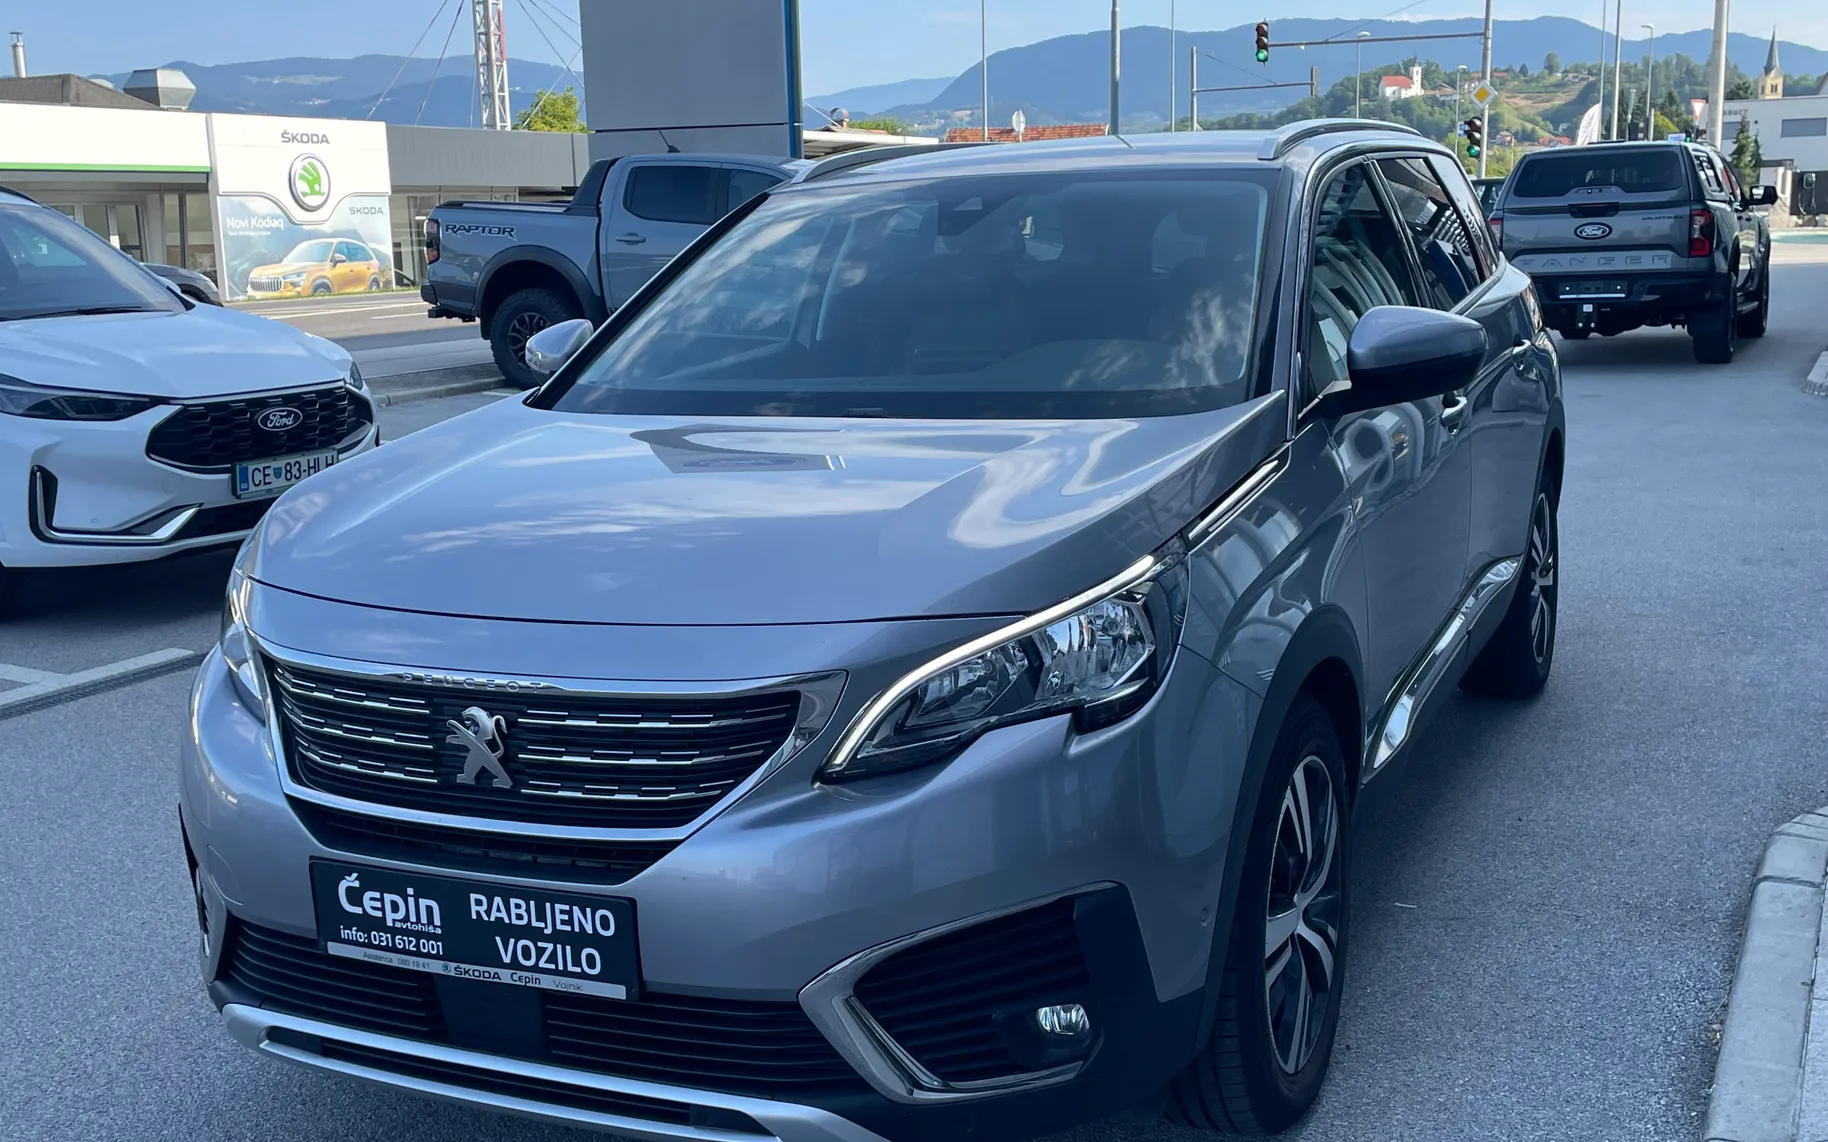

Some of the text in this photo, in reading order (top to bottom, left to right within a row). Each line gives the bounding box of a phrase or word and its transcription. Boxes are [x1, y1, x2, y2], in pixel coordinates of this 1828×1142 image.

[281, 130, 330, 145] ŠKODA
[226, 216, 285, 231] Novi Kodiaq
[444, 223, 518, 242] RAPTOR
[1582, 227, 1603, 237] Ford
[267, 411, 294, 428] Ford
[251, 465, 272, 487] CE
[402, 672, 543, 694] PEUGEOT
[338, 872, 441, 927] Čepin
[469, 892, 616, 937] RABLJENO
[394, 920, 442, 934] avtohiša
[340, 925, 443, 956] info: 031 612 001
[411, 960, 420, 969] 19
[494, 936, 602, 975] VOZILO
[453, 965, 502, 981] ŠKODA
[553, 979, 583, 992] Vojnik
